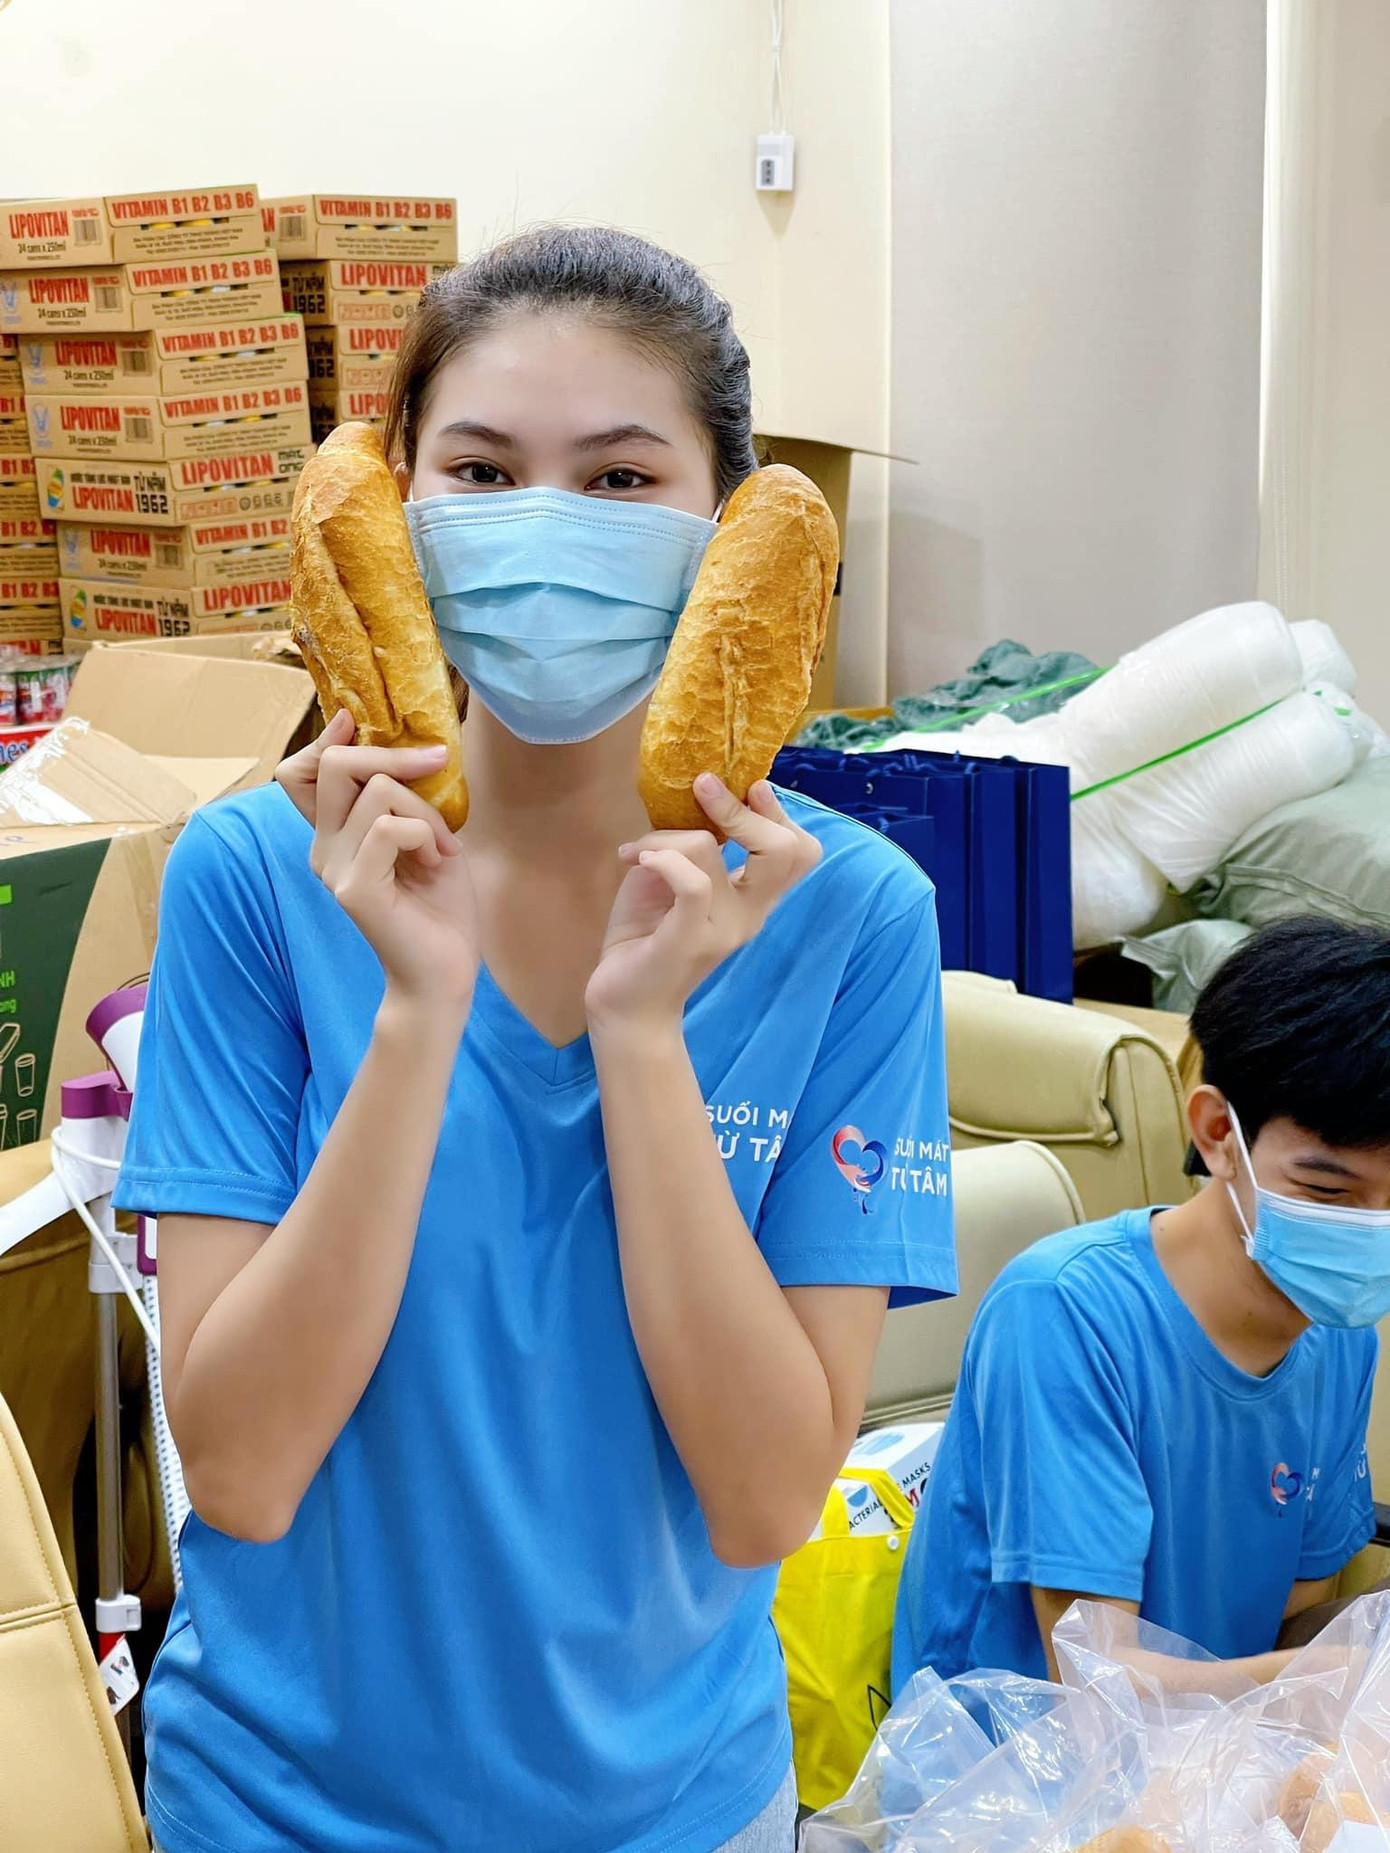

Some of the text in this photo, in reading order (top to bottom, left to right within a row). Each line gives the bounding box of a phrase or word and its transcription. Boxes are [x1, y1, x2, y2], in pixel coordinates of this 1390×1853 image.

[112, 199, 169, 219] VITAMIN
[172, 197, 189, 214] B1
[192, 196, 210, 212] B2
[213, 194, 232, 211] B3
[235, 192, 254, 208] B6
[320, 200, 372, 217] VITAMIN
[376, 202, 391, 217] B1
[395, 202, 410, 218] B2
[415, 203, 432, 219] B3
[436, 203, 453, 219] B6
[9, 211, 69, 239] LIPOVITAN
[132, 267, 188, 287] VITAMIN
[190, 264, 207, 281] B1
[211, 263, 229, 280] B2
[232, 261, 250, 277] B3
[254, 258, 272, 275] B6
[341, 263, 428, 287] LIPOVITAN
[28, 277, 89, 304] LIPOVITAN
[162, 332, 216, 353] VITAMIN
[219, 330, 235, 347] B1
[239, 328, 256, 345] B2
[259, 325, 277, 342] B3
[281, 323, 299, 340] B6
[55, 340, 117, 366] LIPOVITAN
[164, 398, 219, 418] VITAMIN
[223, 395, 238, 412] B1
[242, 392, 259, 409] B2
[263, 390, 280, 406] B3
[284, 387, 301, 403] B6
[60, 405, 121, 431] LIPOVITAN
[181, 453, 274, 485] LIPOVITAN
[72, 486, 135, 512] LIPOVITAN
[136, 494, 169, 513] 1962
[196, 524, 248, 546] VITAMIN
[95, 608, 158, 637] LIPOVITAN
[767, 1108, 790, 1129] M
[714, 1130, 740, 1160] Ừ
[919, 1139, 949, 1162] MÁT
[910, 1165, 948, 1197] TÂM
[902, 1462, 932, 1488] MASKS
